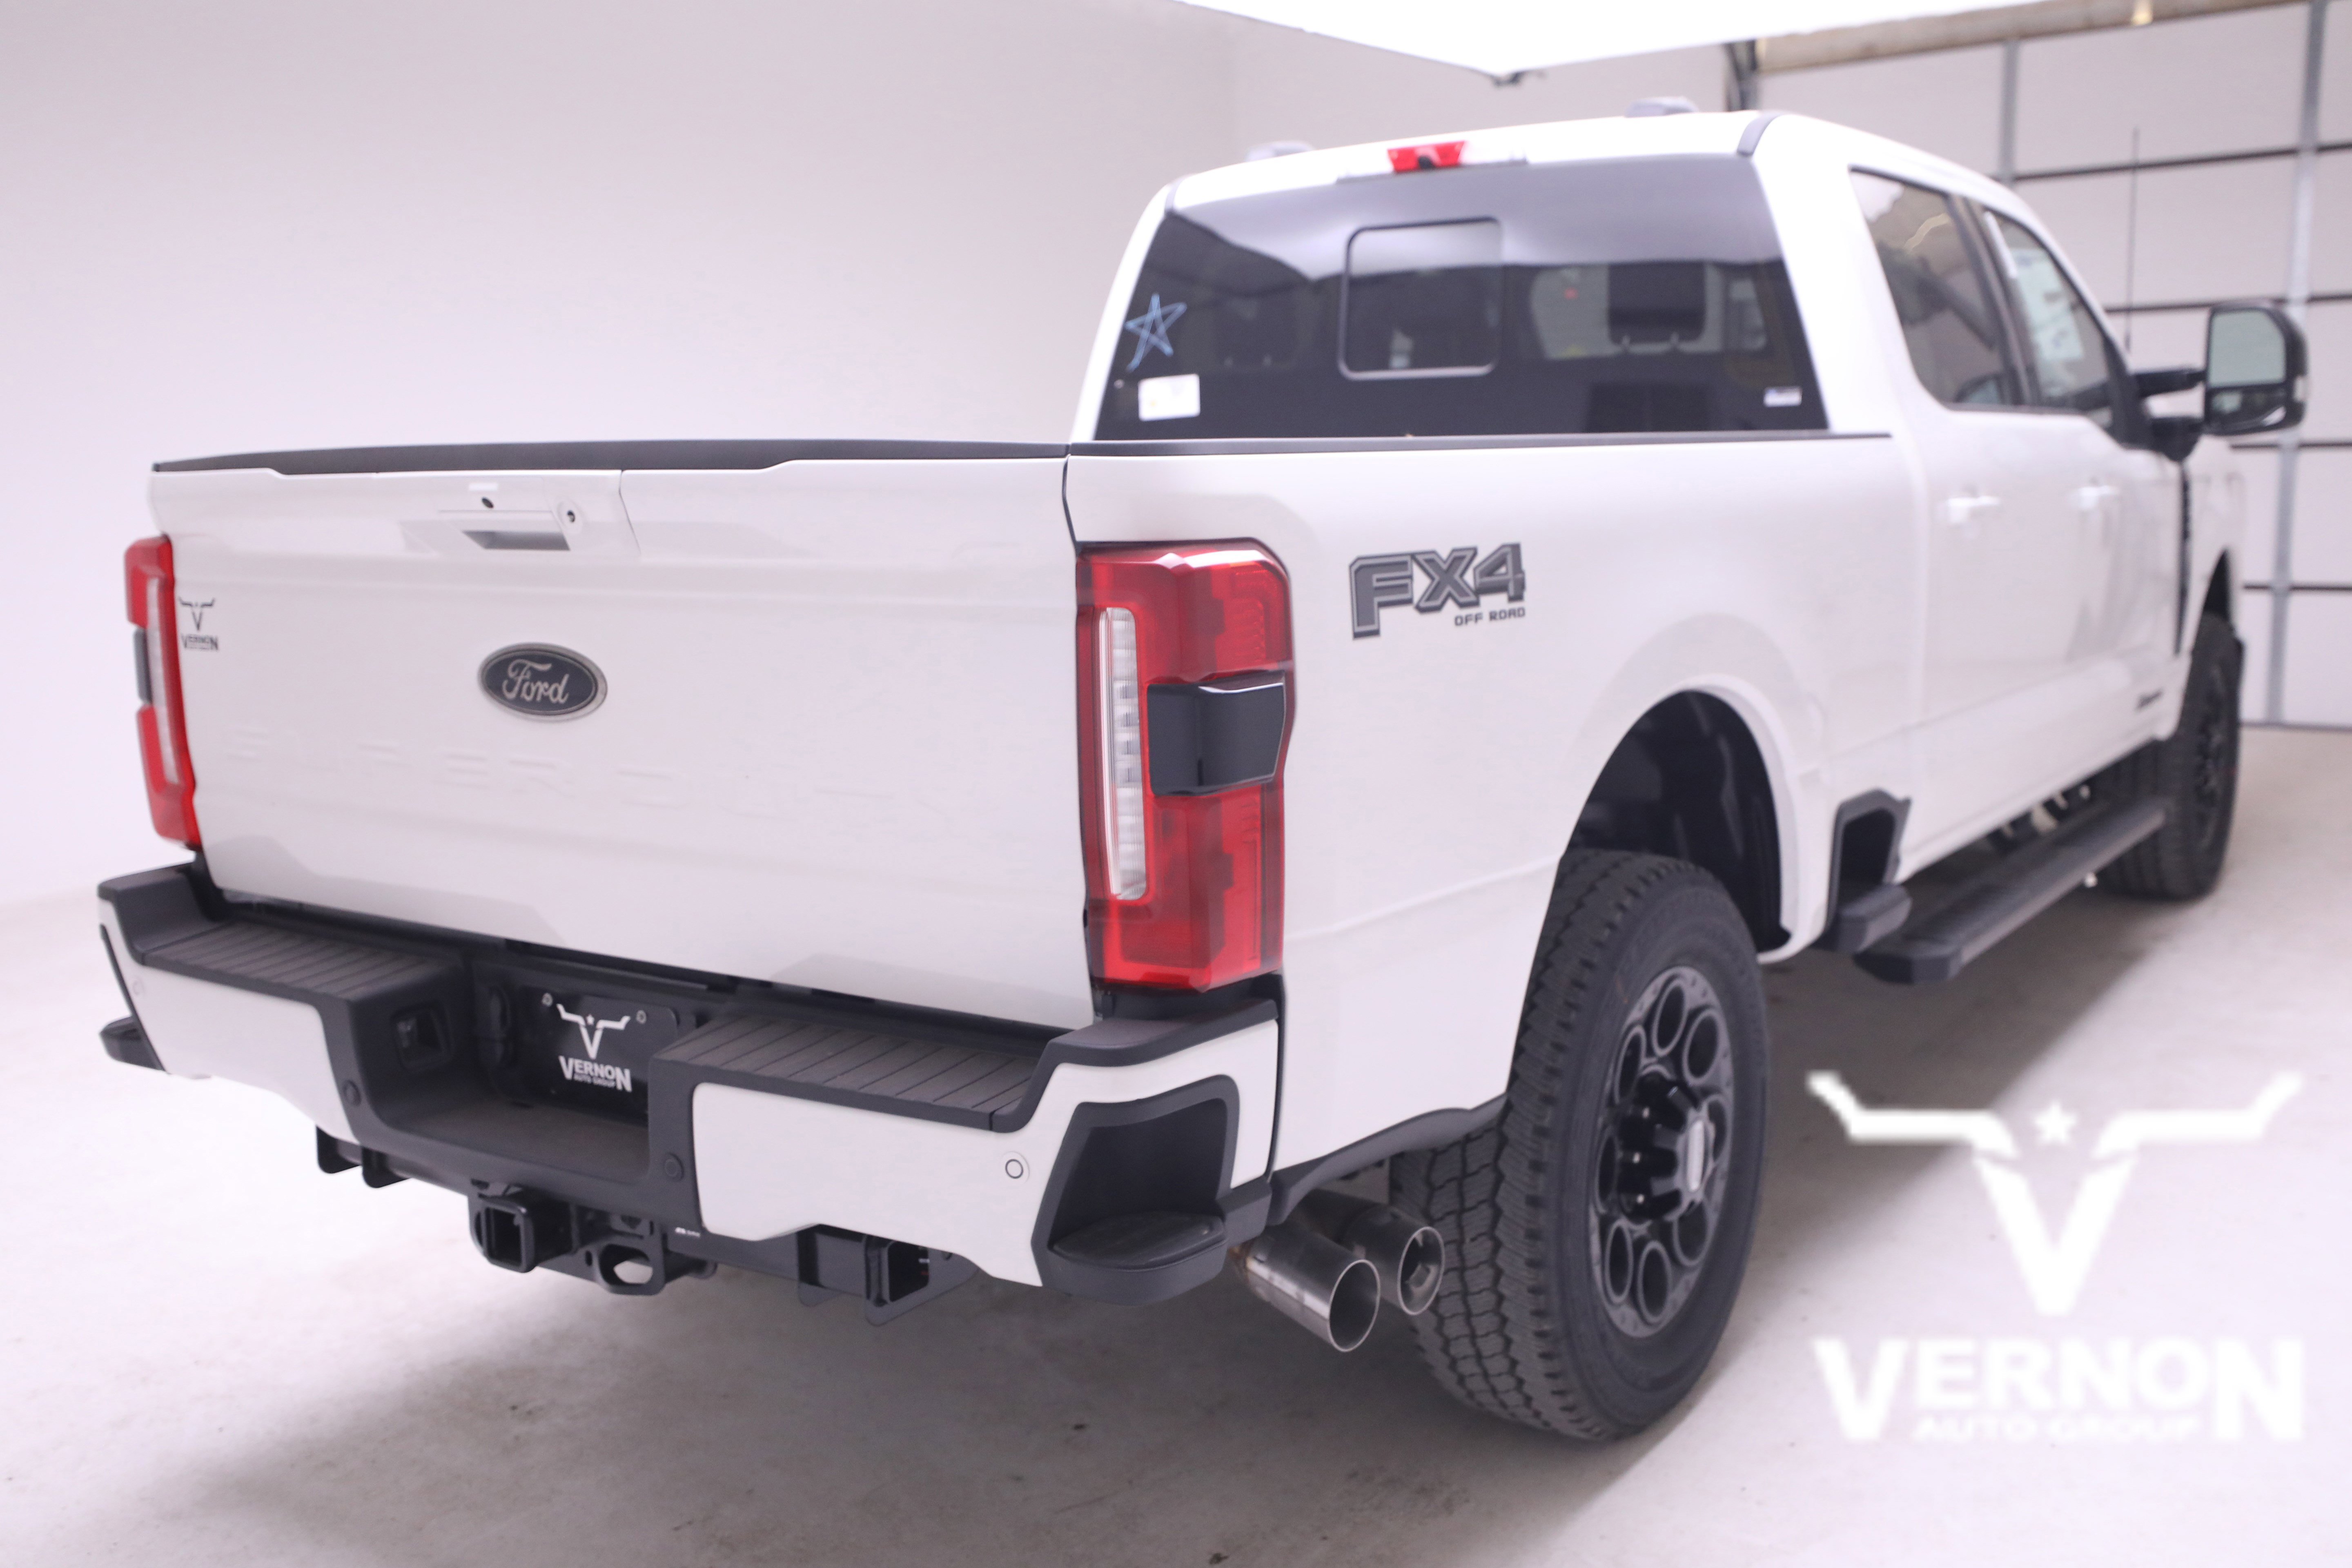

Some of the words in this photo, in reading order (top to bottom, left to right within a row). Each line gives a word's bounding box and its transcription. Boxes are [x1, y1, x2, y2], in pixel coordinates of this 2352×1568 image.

[1348, 542, 1526, 640] FX4
[1454, 612, 1483, 626] OFF
[1489, 607, 1526, 622] ROAD
[501, 658, 569, 705] Ford
[558, 1055, 633, 1093] VERNON
